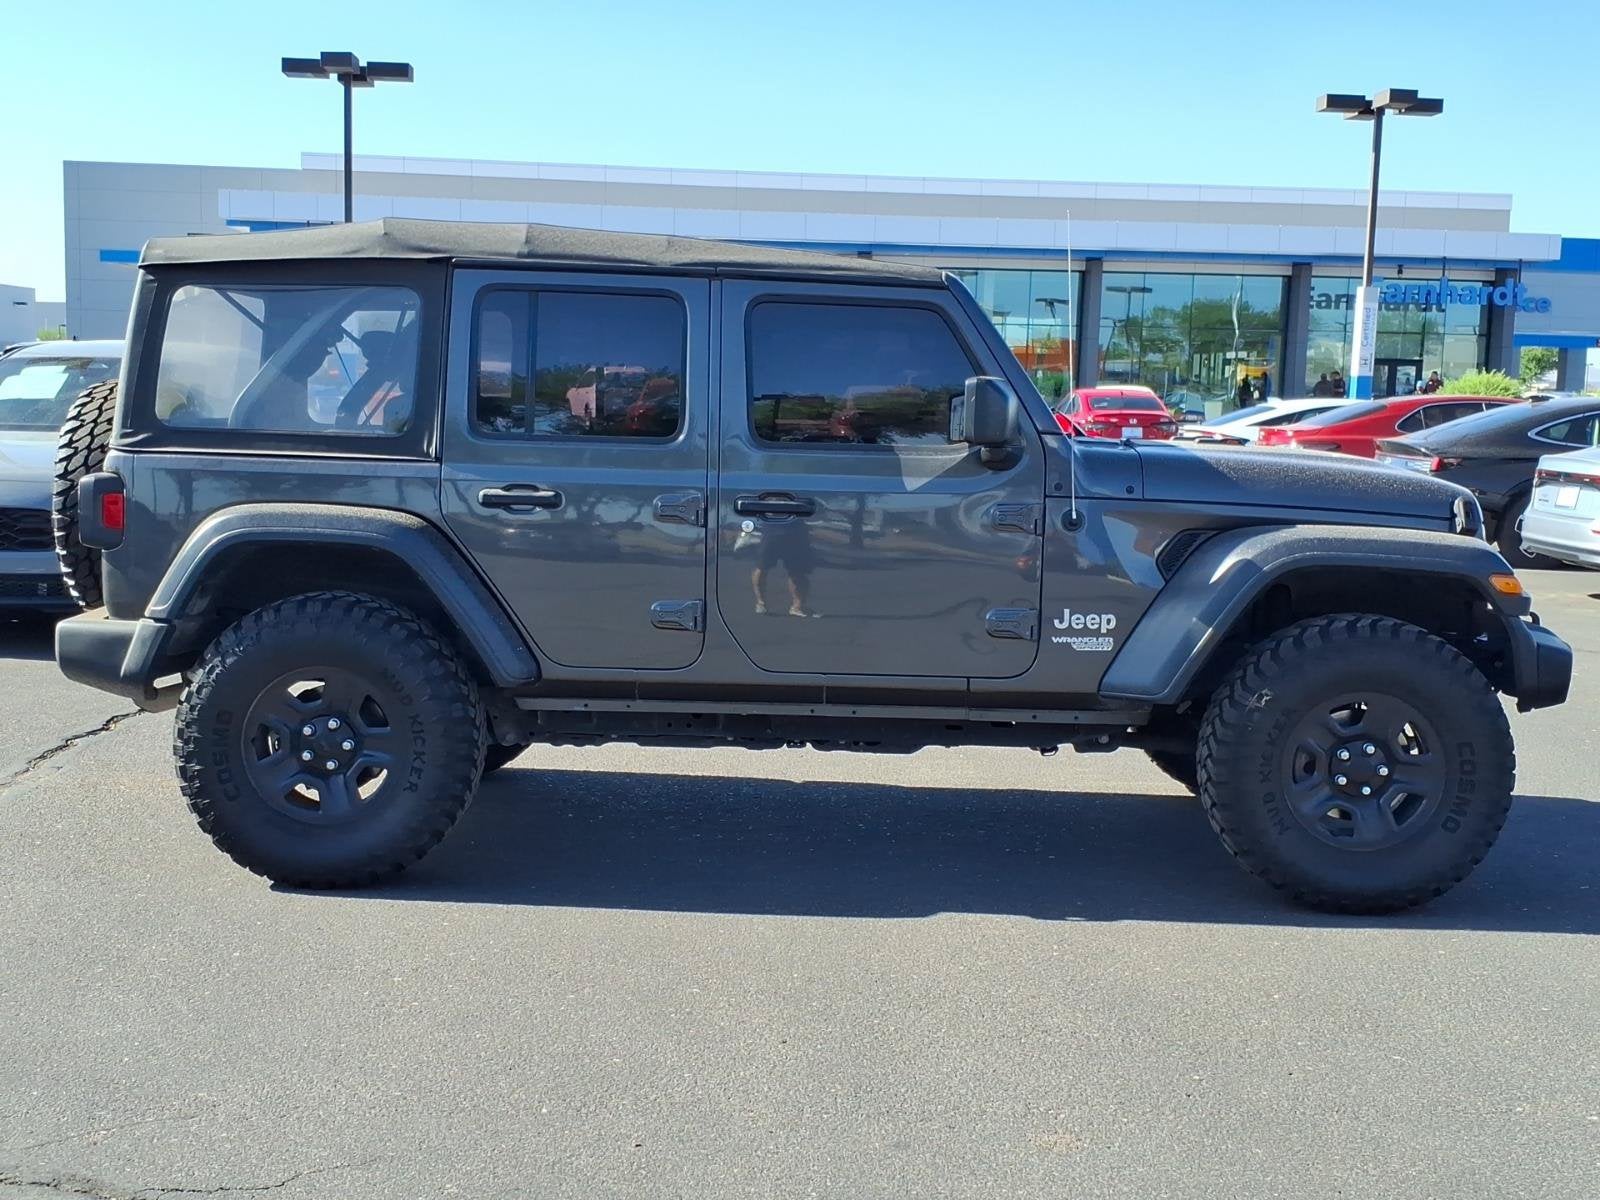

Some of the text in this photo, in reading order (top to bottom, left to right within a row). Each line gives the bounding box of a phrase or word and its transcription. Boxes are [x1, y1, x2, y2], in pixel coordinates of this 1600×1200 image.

[1051, 636, 1114, 644] WRANGLER
[1053, 608, 1117, 633] Jeep
[402, 713, 427, 793] KICKER
[1440, 741, 1476, 834] COSMO
